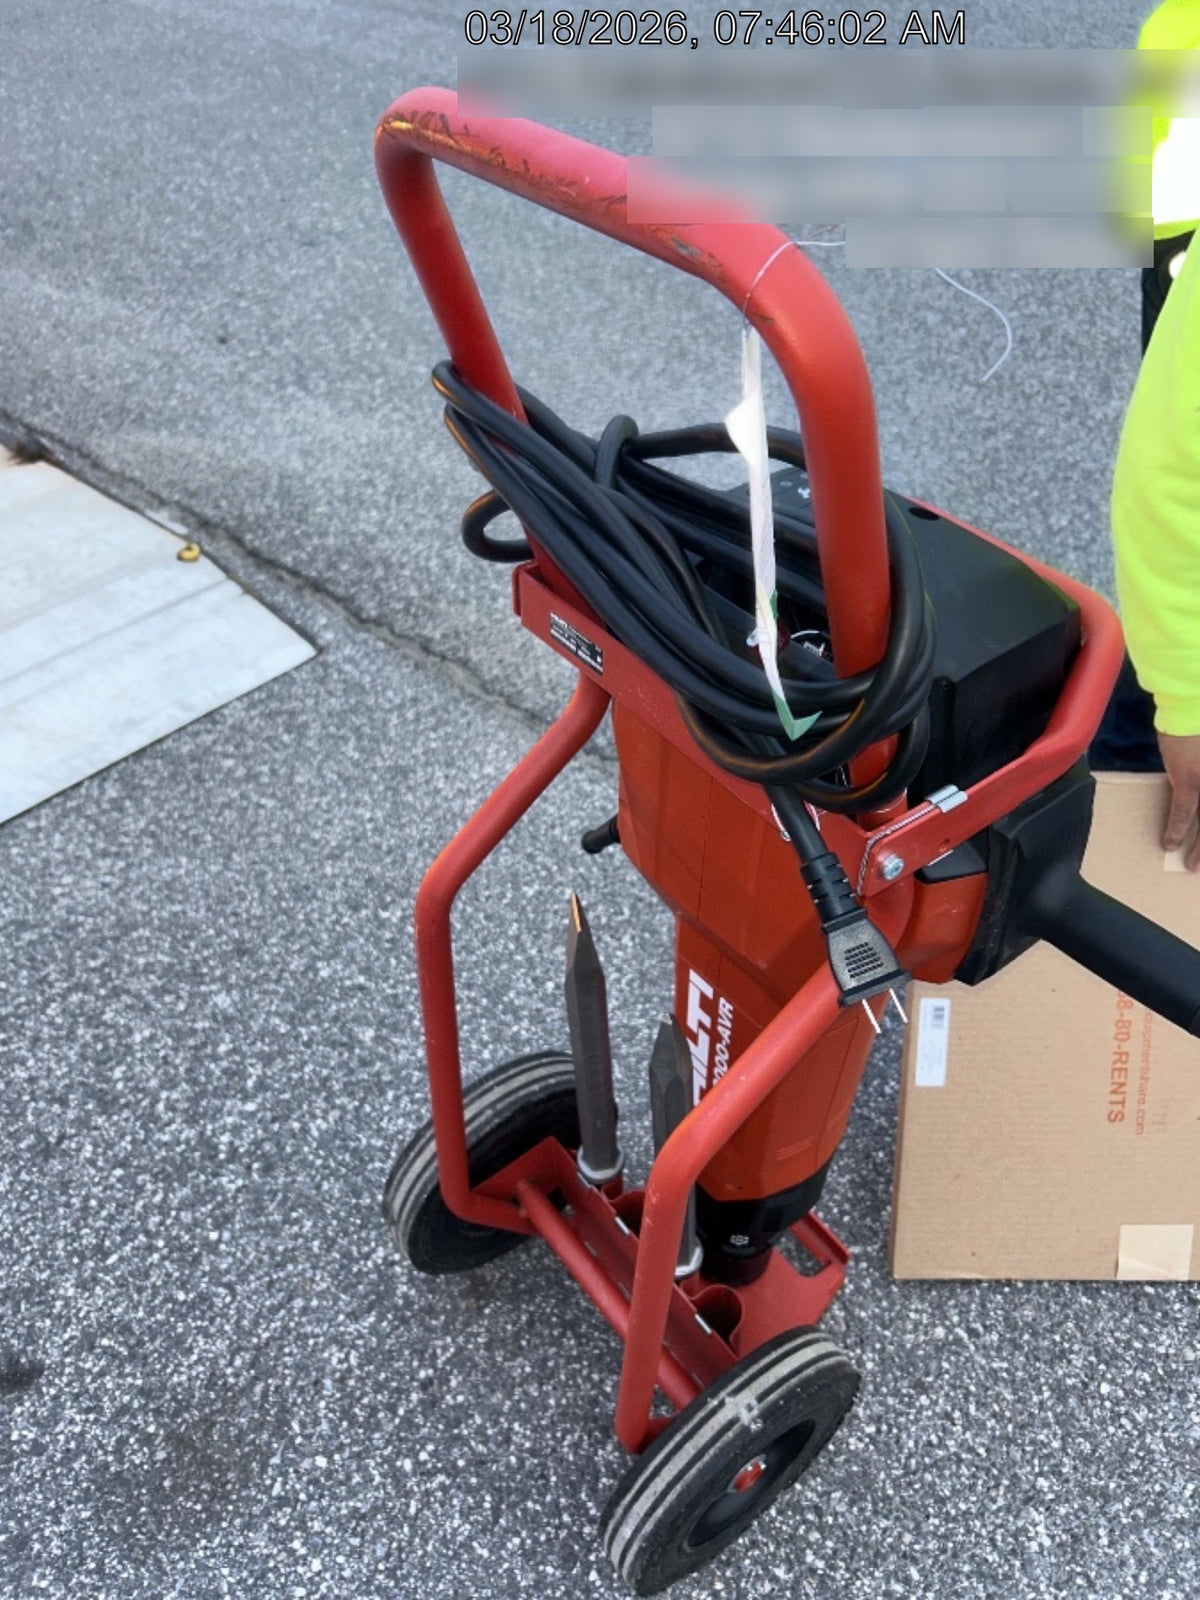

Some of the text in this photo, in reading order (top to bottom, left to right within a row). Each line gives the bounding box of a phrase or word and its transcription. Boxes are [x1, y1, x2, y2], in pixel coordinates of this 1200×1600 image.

[713, 996, 734, 1087] 000-AVR
[1107, 990, 1134, 1124] 8-80-RENTS
[1135, 1009, 1154, 1136] quipmentshare.com
